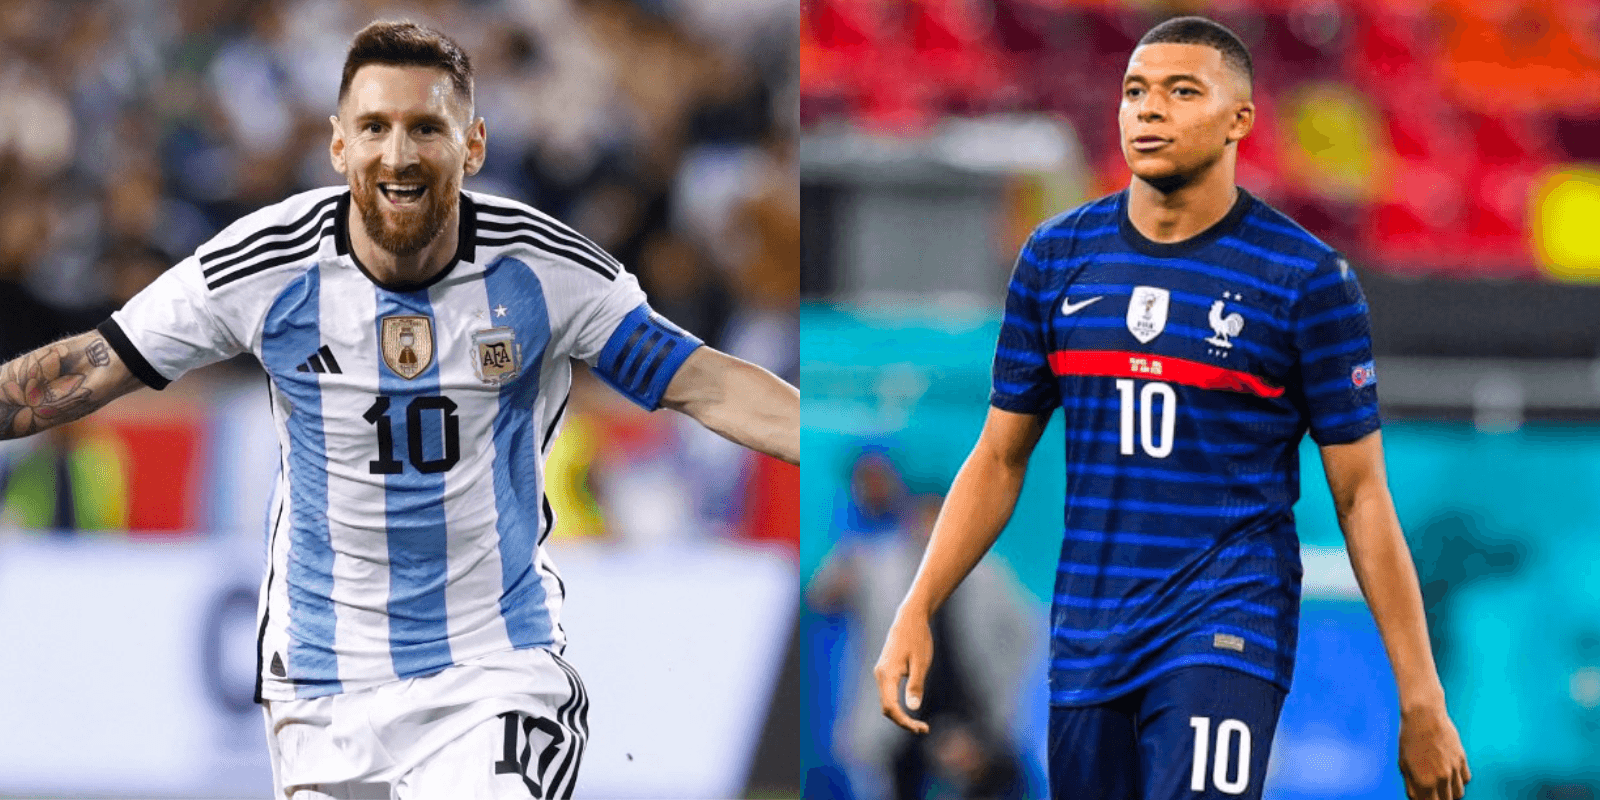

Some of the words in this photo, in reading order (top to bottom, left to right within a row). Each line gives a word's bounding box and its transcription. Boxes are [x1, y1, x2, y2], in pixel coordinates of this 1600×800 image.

[482, 342, 512, 368] AFA
[362, 396, 460, 475] 10
[1116, 379, 1176, 458] 10
[495, 711, 565, 799] 10
[1190, 716, 1252, 795] 10
